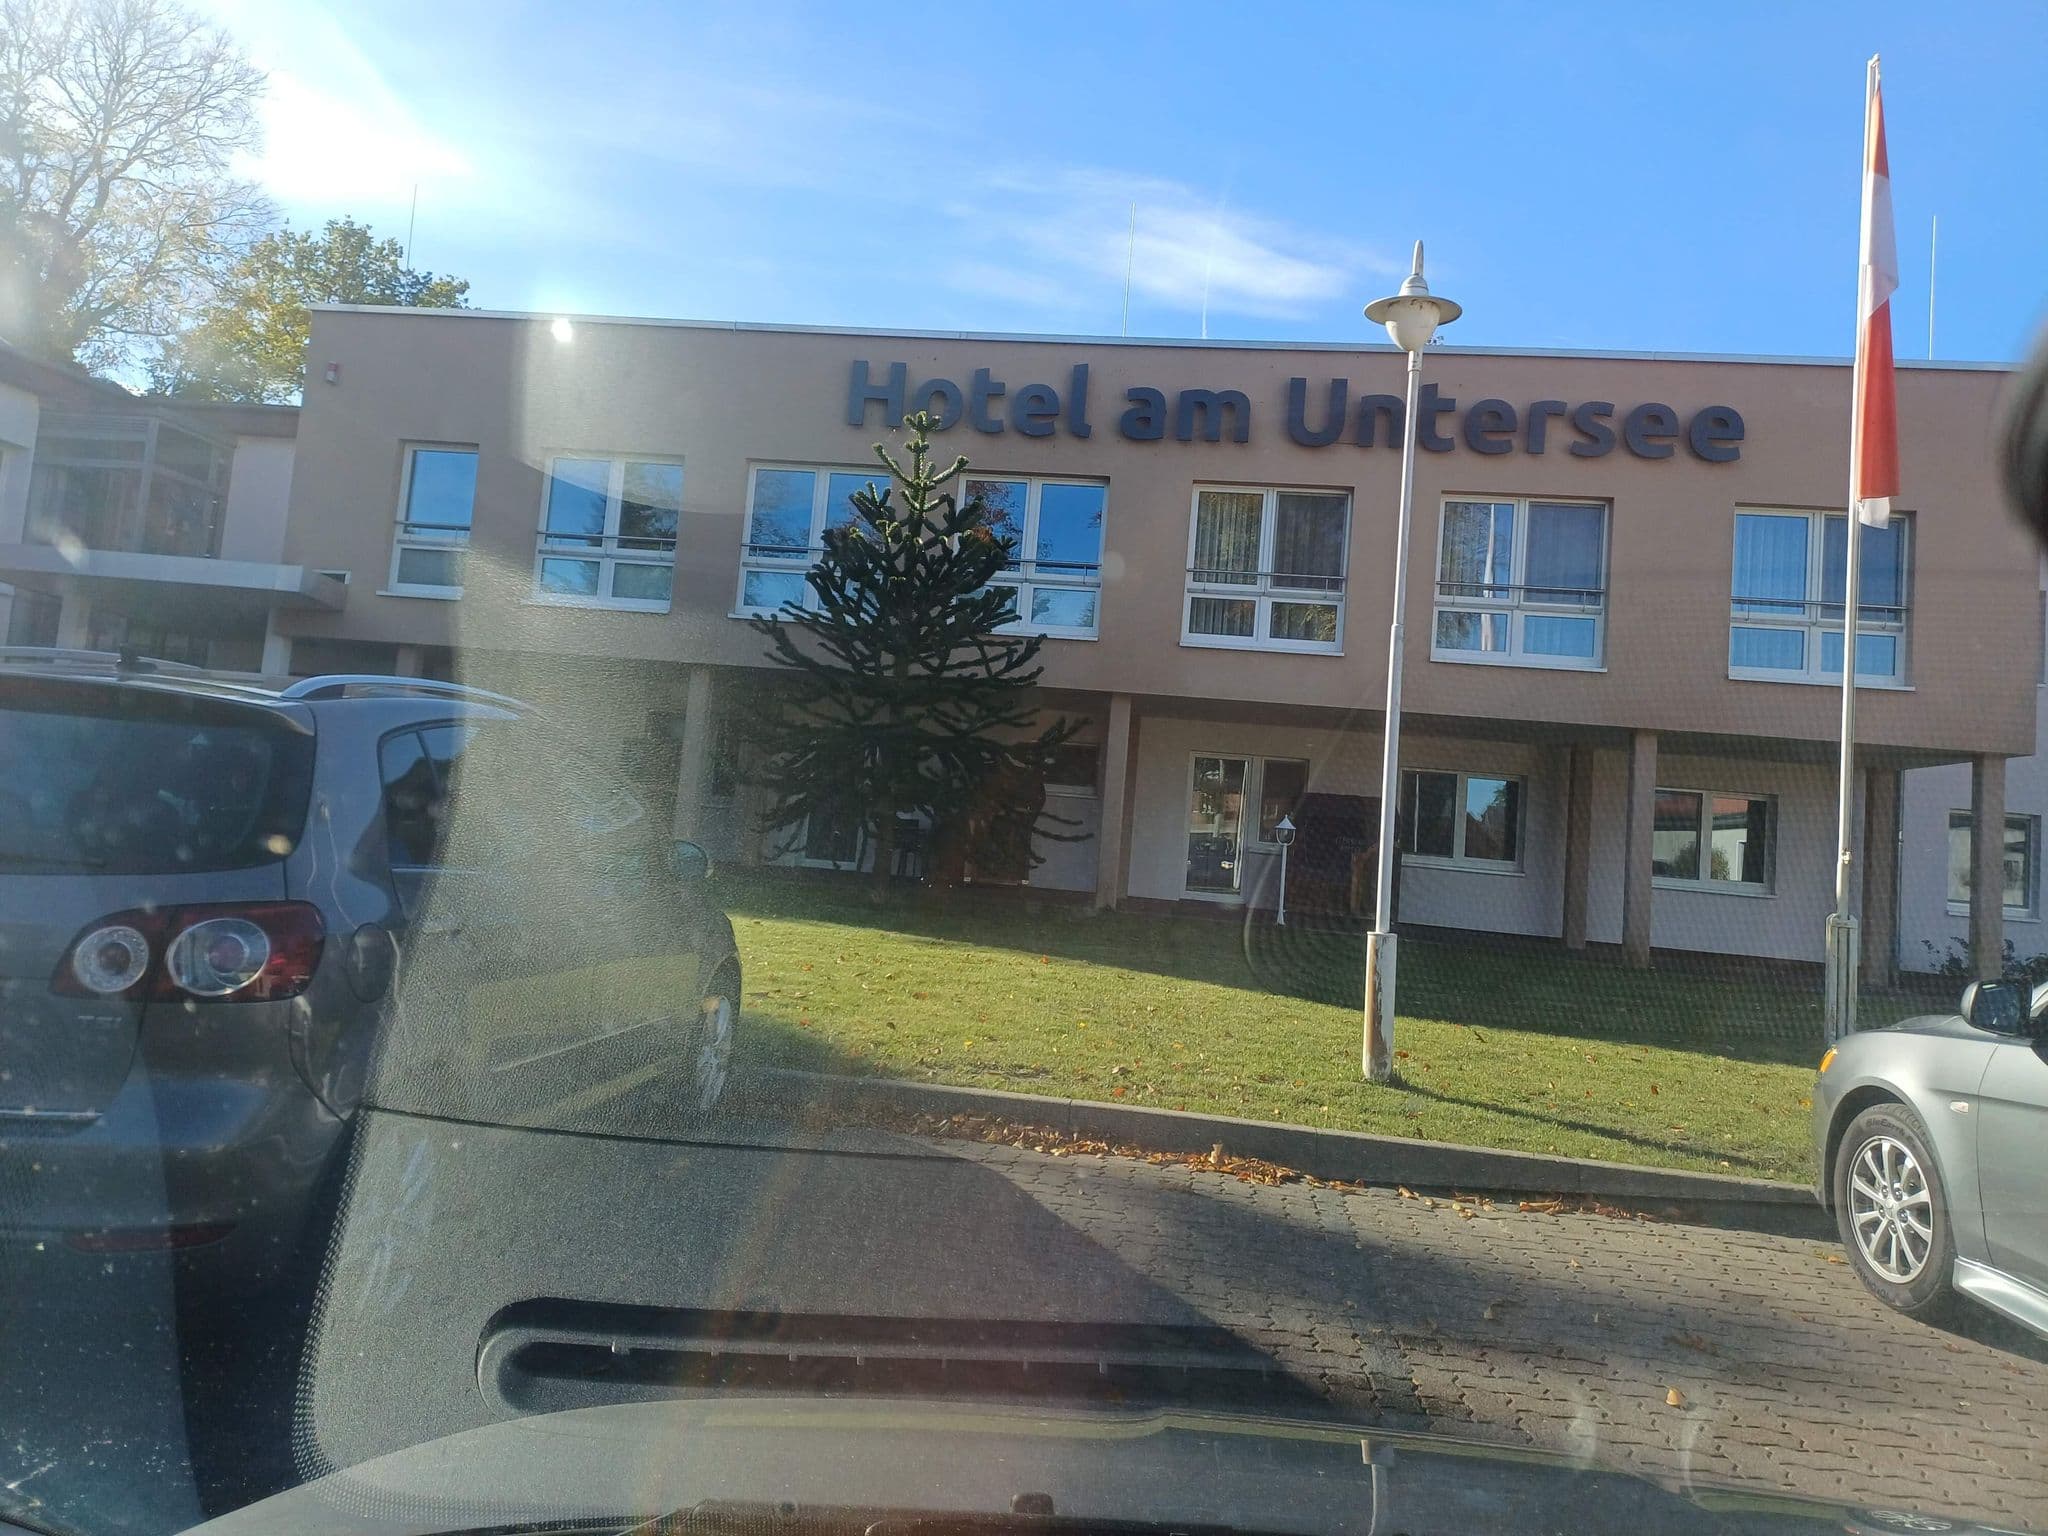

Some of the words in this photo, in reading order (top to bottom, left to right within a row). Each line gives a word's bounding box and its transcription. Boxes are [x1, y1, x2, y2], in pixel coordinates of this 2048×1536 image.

[848, 360, 1091, 439] Hotel
[1120, 386, 1251, 443] am
[1287, 377, 1746, 462] Untersee
